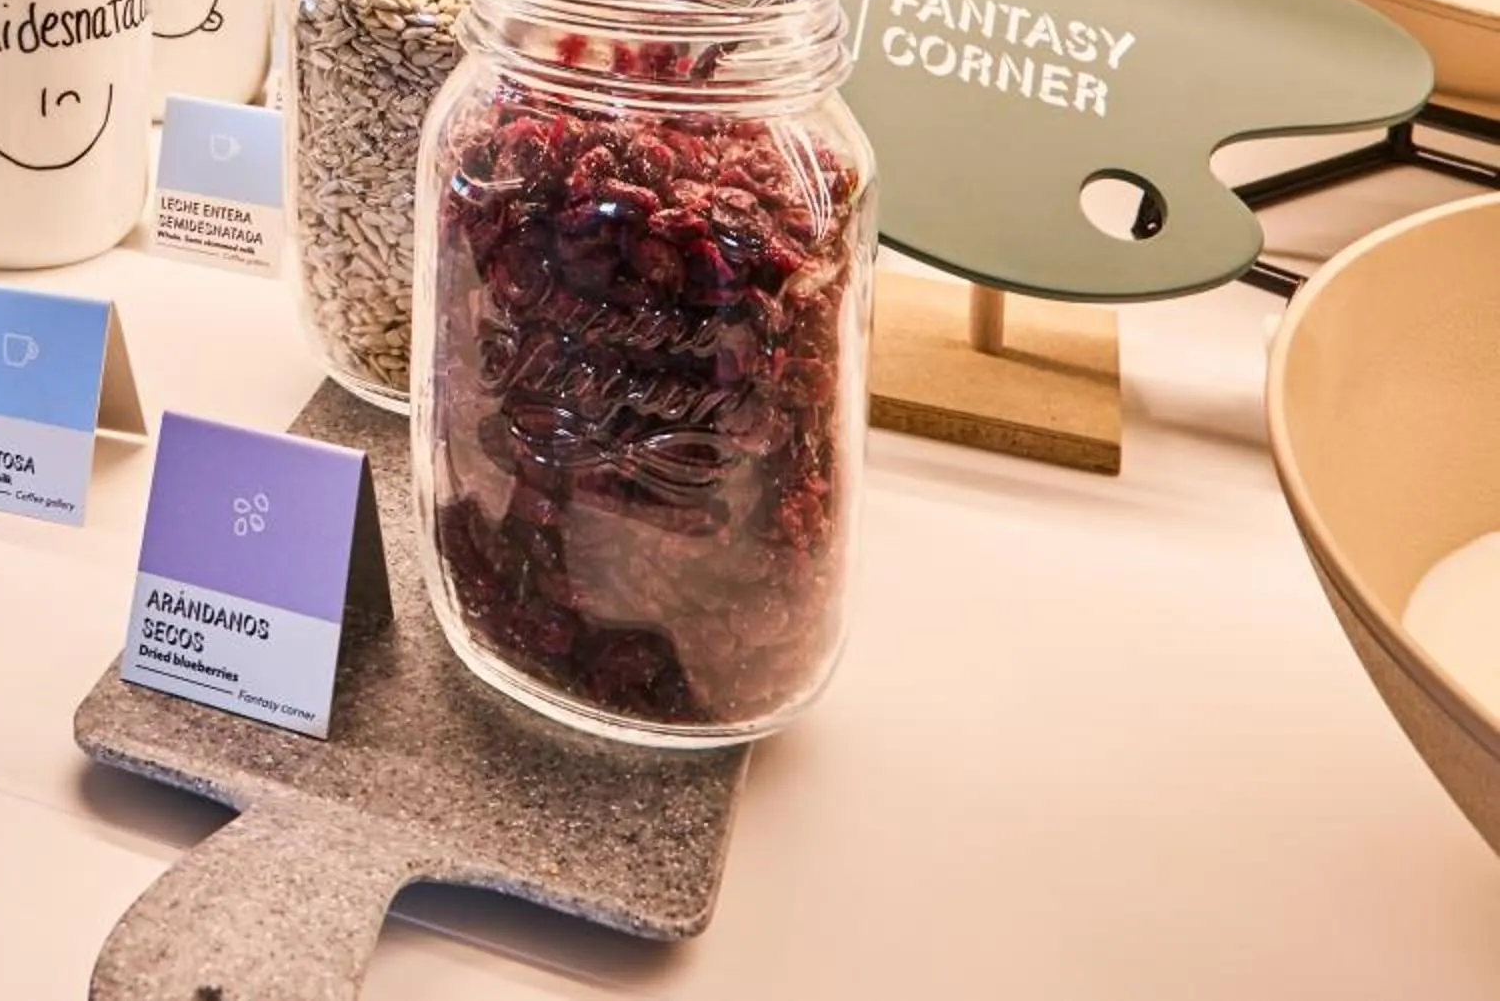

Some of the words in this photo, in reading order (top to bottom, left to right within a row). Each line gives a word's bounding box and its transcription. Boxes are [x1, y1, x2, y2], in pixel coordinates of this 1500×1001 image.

[882, 26, 1109, 117] CORNER
[160, 196, 202, 216] LECHE
[203, 204, 253, 225] ENTERA
[158, 214, 263, 245] SEMIDESNATADA
[146, 588, 270, 640] ARÁNDANOS
[141, 617, 205, 653] SECOS
[138, 644, 172, 664] Dried
[172, 651, 239, 683] blueberries
[237, 690, 280, 713] Fantasy
[280, 702, 317, 722] corner
